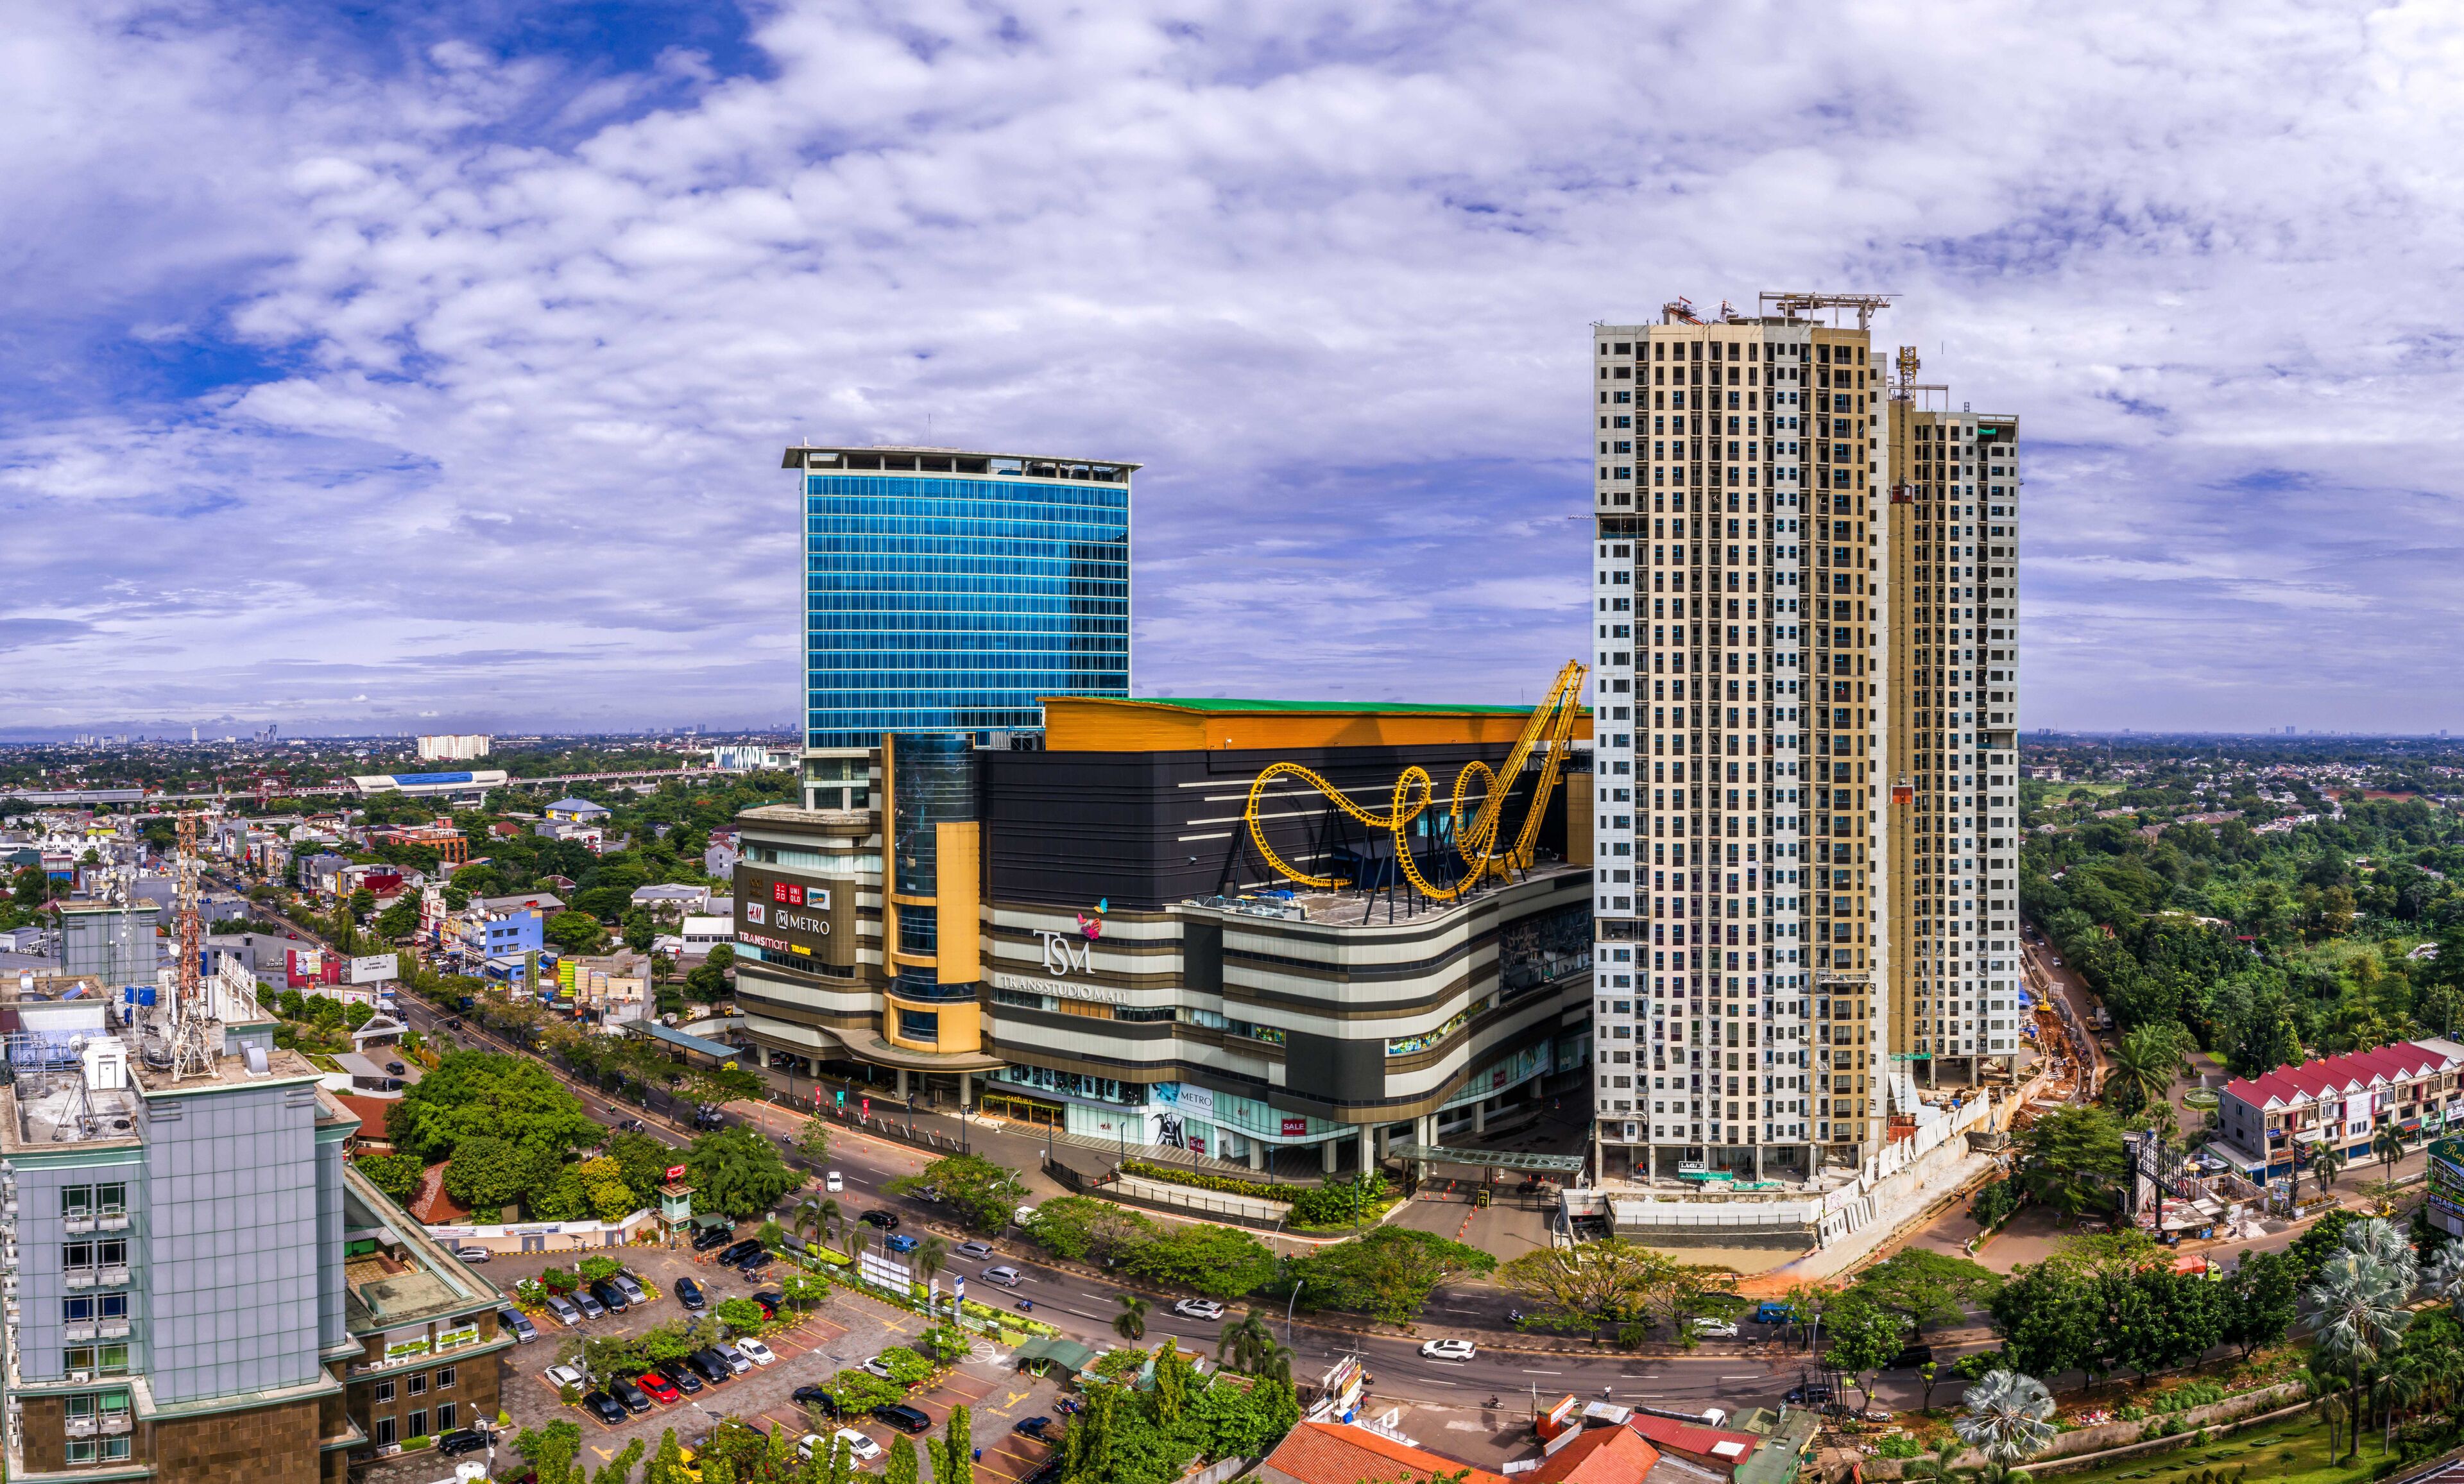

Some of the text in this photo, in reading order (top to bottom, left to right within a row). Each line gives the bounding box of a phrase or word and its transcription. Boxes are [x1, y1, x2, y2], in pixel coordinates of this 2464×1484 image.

[748, 905, 762, 922] H&M
[790, 915, 830, 935] METRO
[739, 931, 789, 952] TRANSmart
[1033, 929, 1096, 976] TSM
[1002, 975, 1130, 1005] TRANS STUDIO MALL
[1181, 1091, 1212, 1106] METRO
